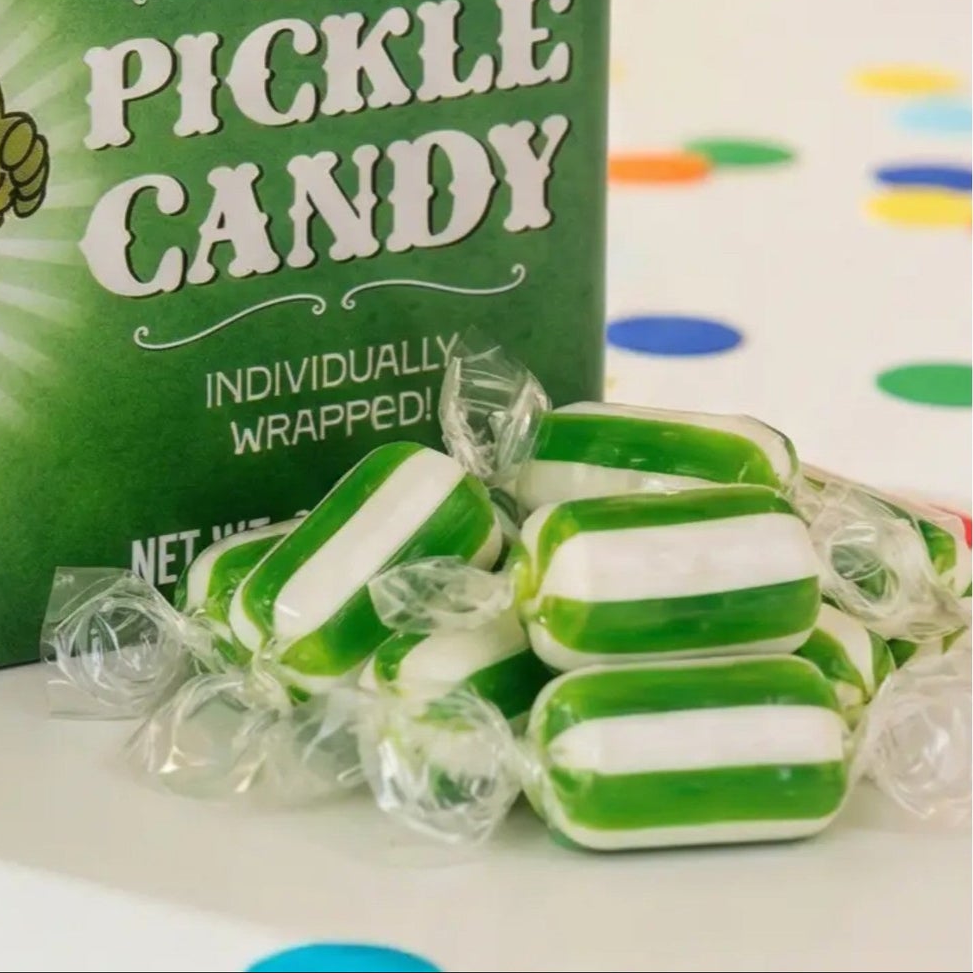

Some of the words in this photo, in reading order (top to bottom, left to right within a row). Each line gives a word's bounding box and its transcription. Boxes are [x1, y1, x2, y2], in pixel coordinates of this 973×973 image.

[78, 114, 570, 298] CANDY
[205, 331, 460, 409] INDIVIDUALLY
[131, 529, 201, 587] NET
